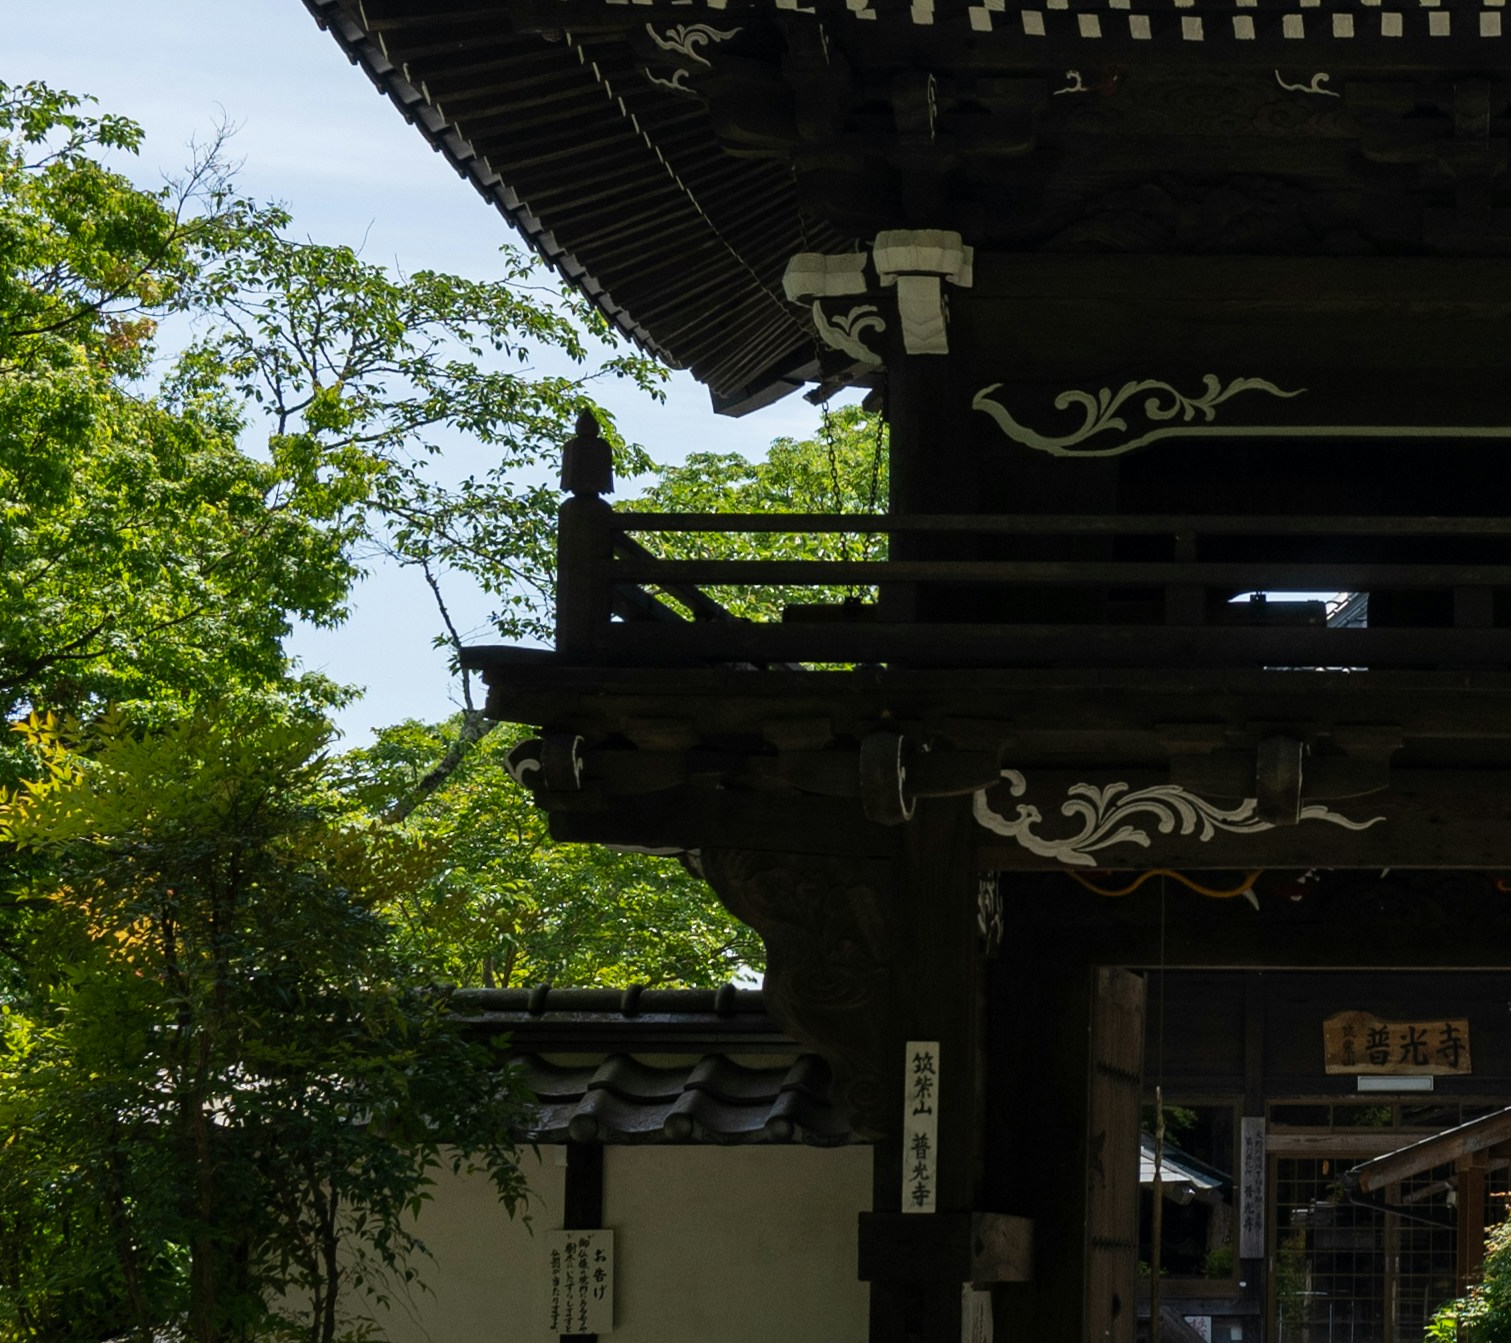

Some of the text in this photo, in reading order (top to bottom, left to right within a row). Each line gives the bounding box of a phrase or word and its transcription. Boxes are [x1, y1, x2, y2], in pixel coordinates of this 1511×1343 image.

[1364, 1022, 1466, 1069] 普光寺
[909, 1051, 936, 1207] 筑紫山 普光寺
[593, 1248, 607, 1301] お告げ
